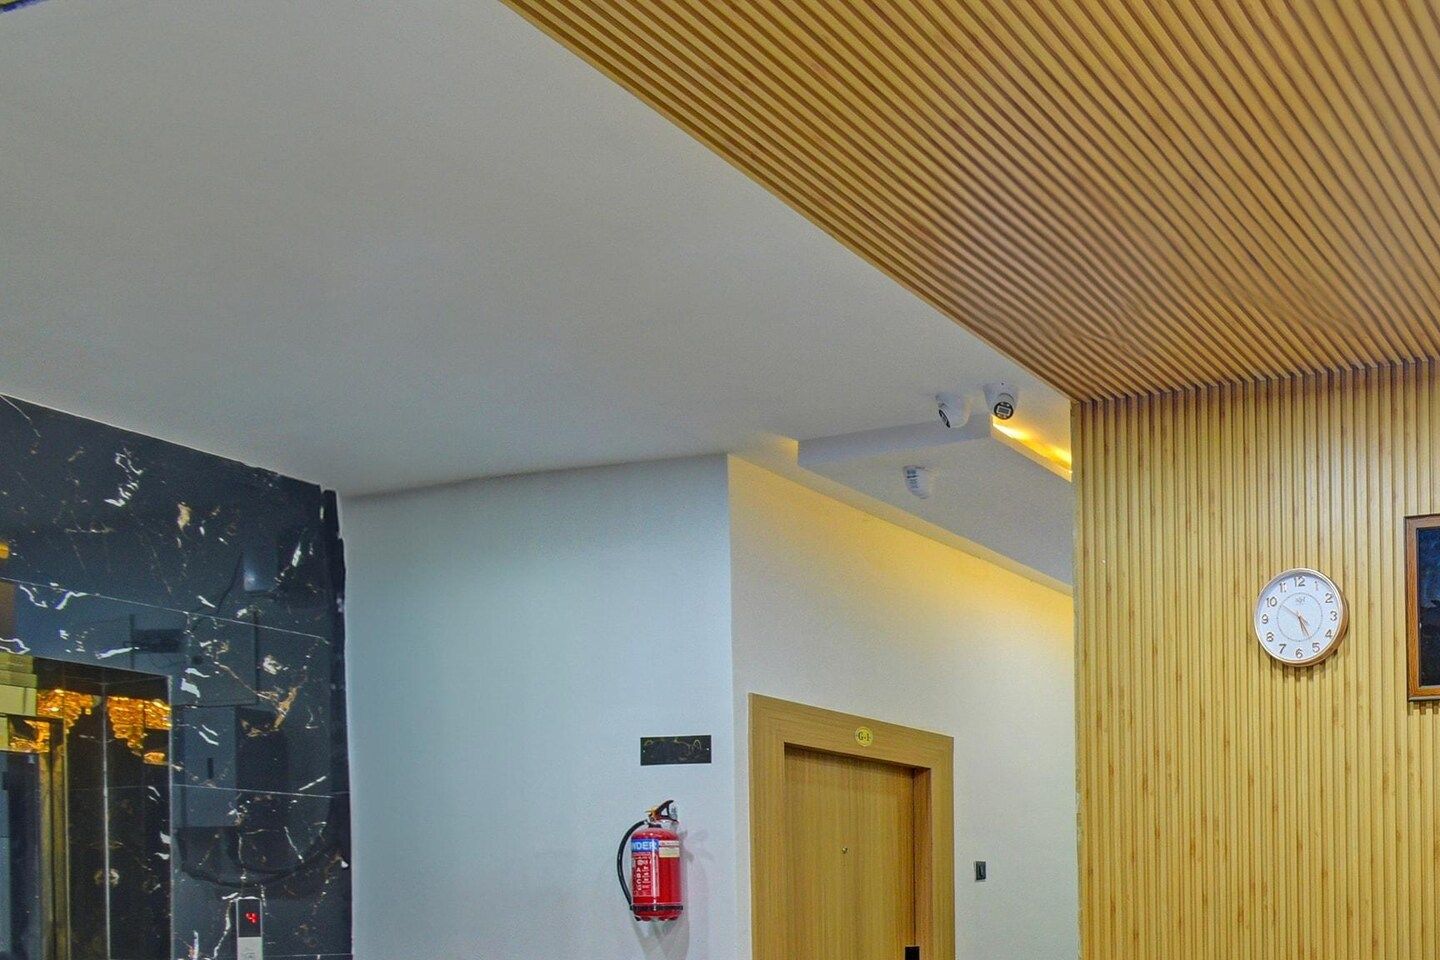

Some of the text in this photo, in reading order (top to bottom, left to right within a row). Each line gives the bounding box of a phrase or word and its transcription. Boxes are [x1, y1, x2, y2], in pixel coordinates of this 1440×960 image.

[1294, 576, 1306, 587] 12
[1280, 582, 1287, 592] 11
[1266, 597, 1277, 607] 10
[1325, 593, 1334, 603] 2
[1261, 614, 1269, 624] 9
[1330, 611, 1338, 621] 3
[1266, 632, 1274, 642] 8
[1325, 629, 1332, 638] 4
[1279, 644, 1287, 654] 7
[1312, 642, 1320, 653] 5
[1295, 648, 1303, 658] 6
